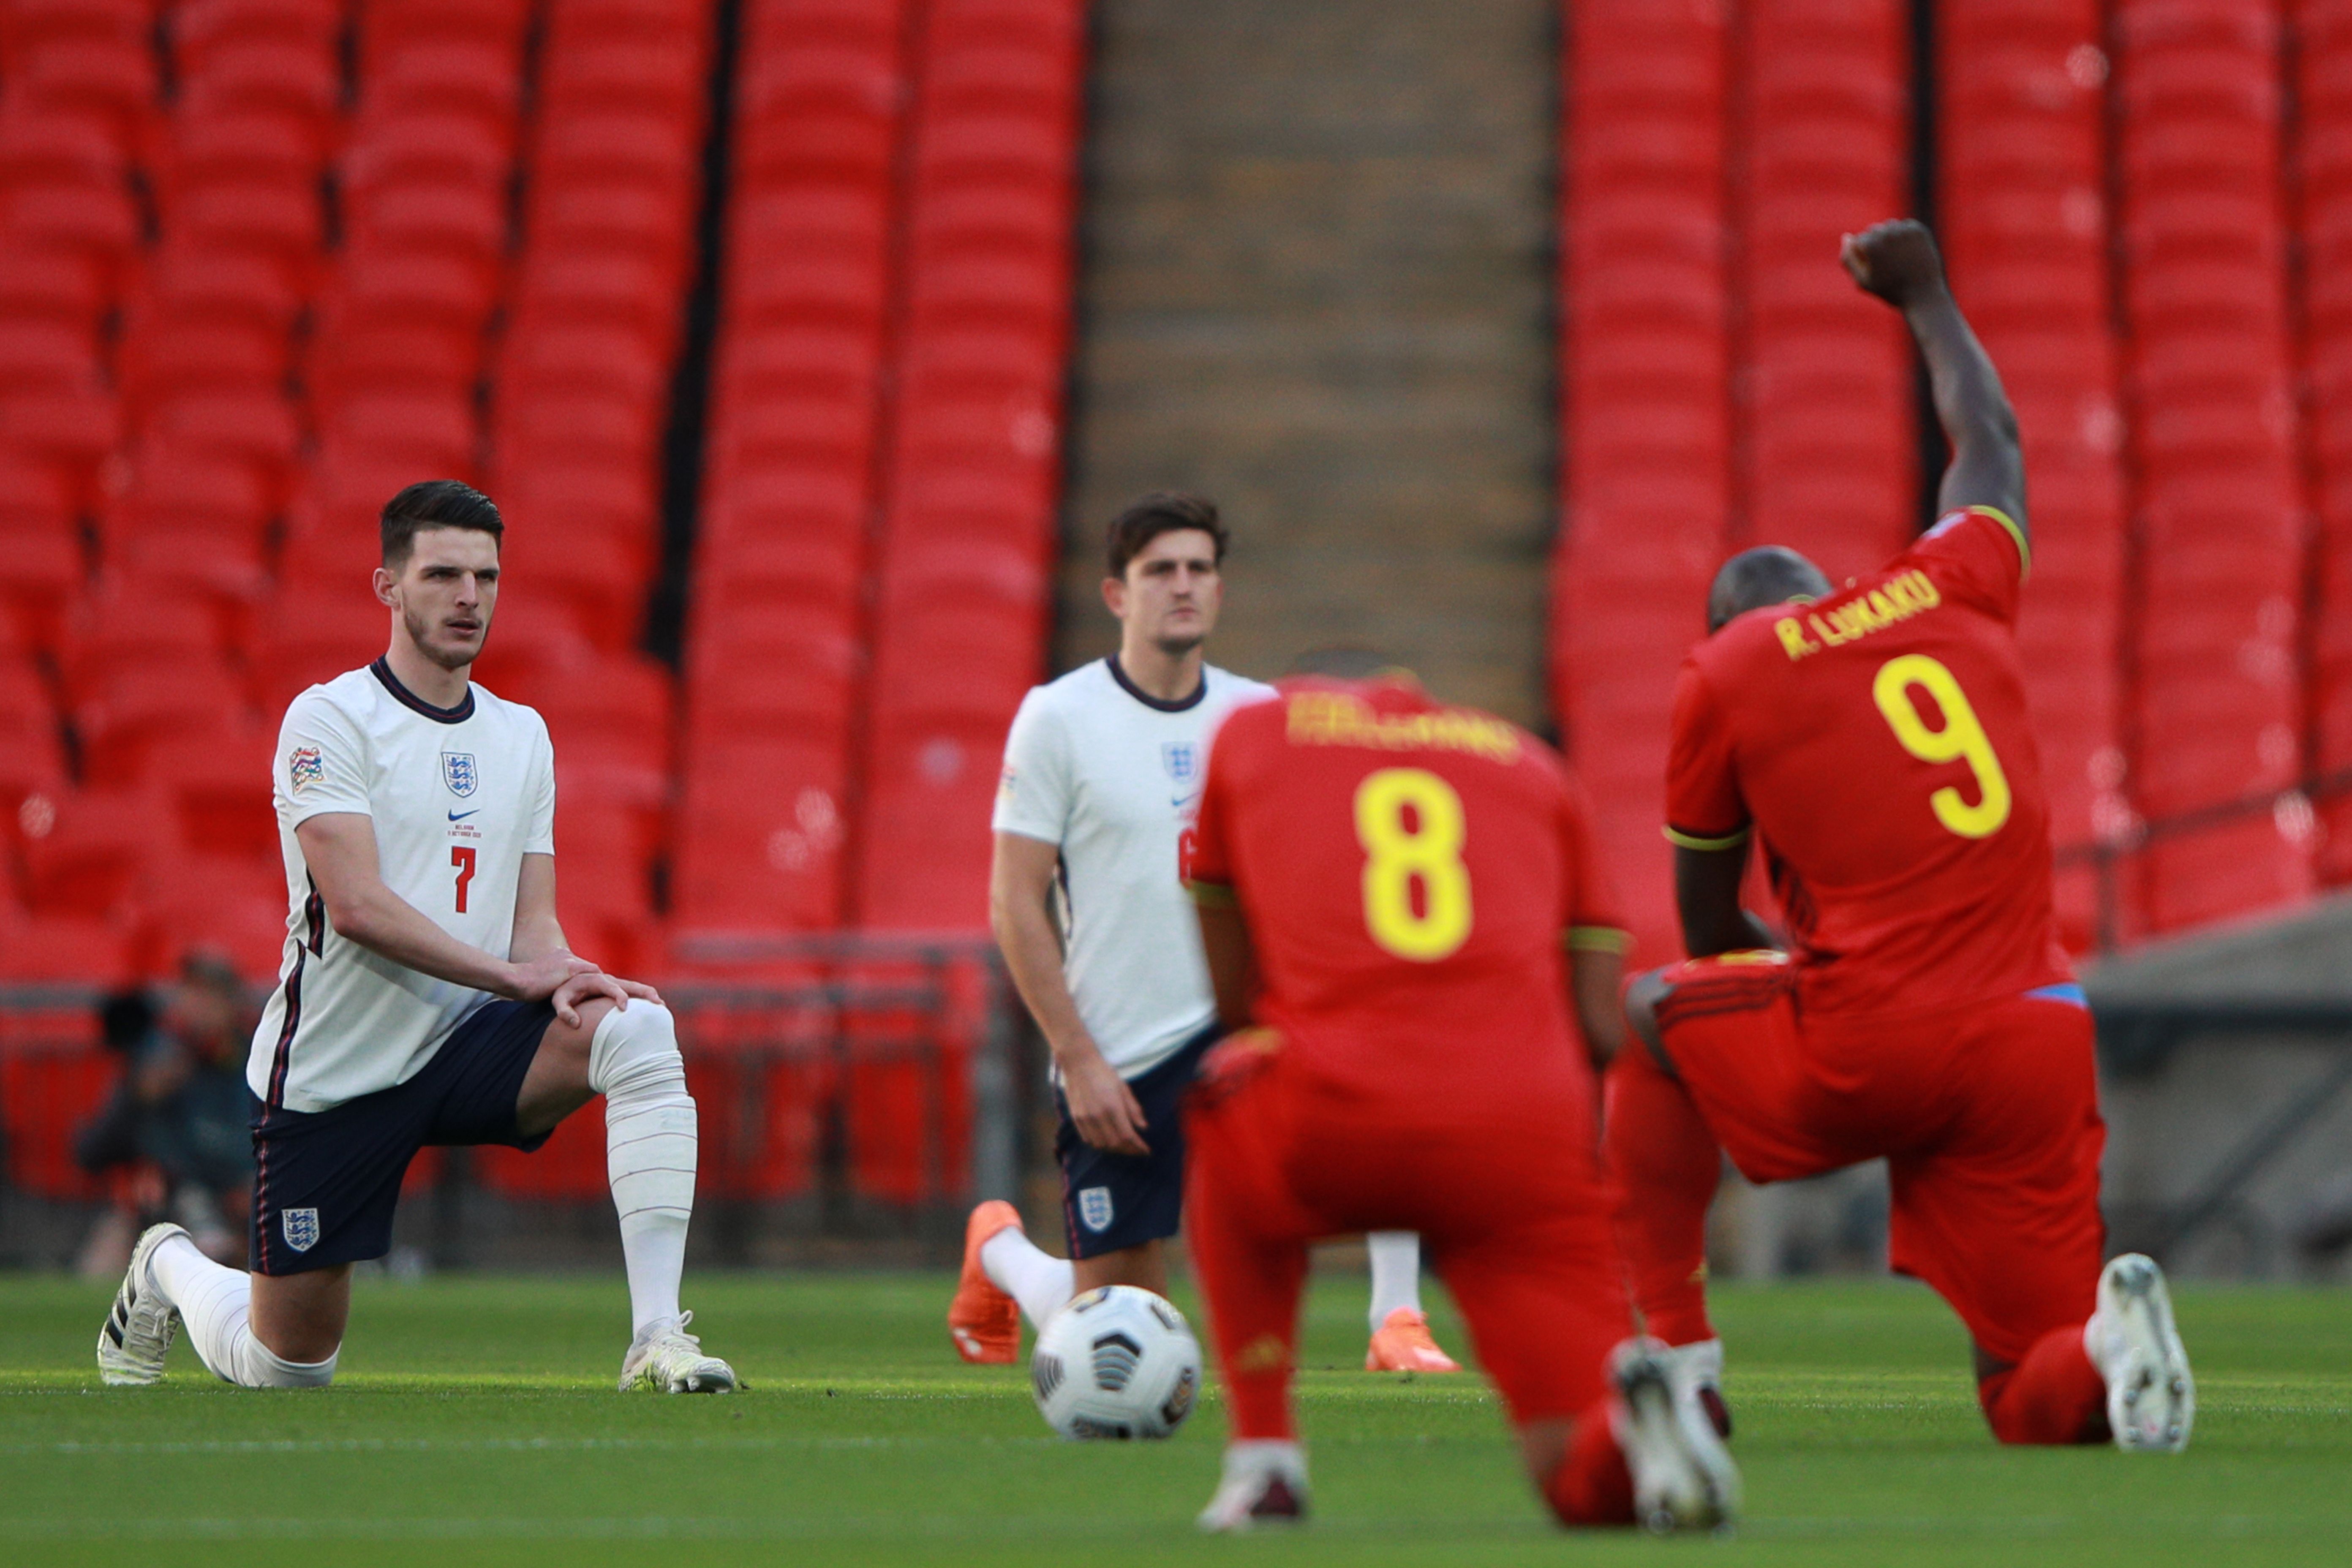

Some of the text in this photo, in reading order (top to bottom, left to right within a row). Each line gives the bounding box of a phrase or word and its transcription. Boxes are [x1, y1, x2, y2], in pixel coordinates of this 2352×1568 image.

[1774, 569, 1941, 660] R. LUKAKU
[1874, 654, 2011, 837] 9
[451, 846, 476, 913] 7
[1356, 769, 1471, 959] 8
